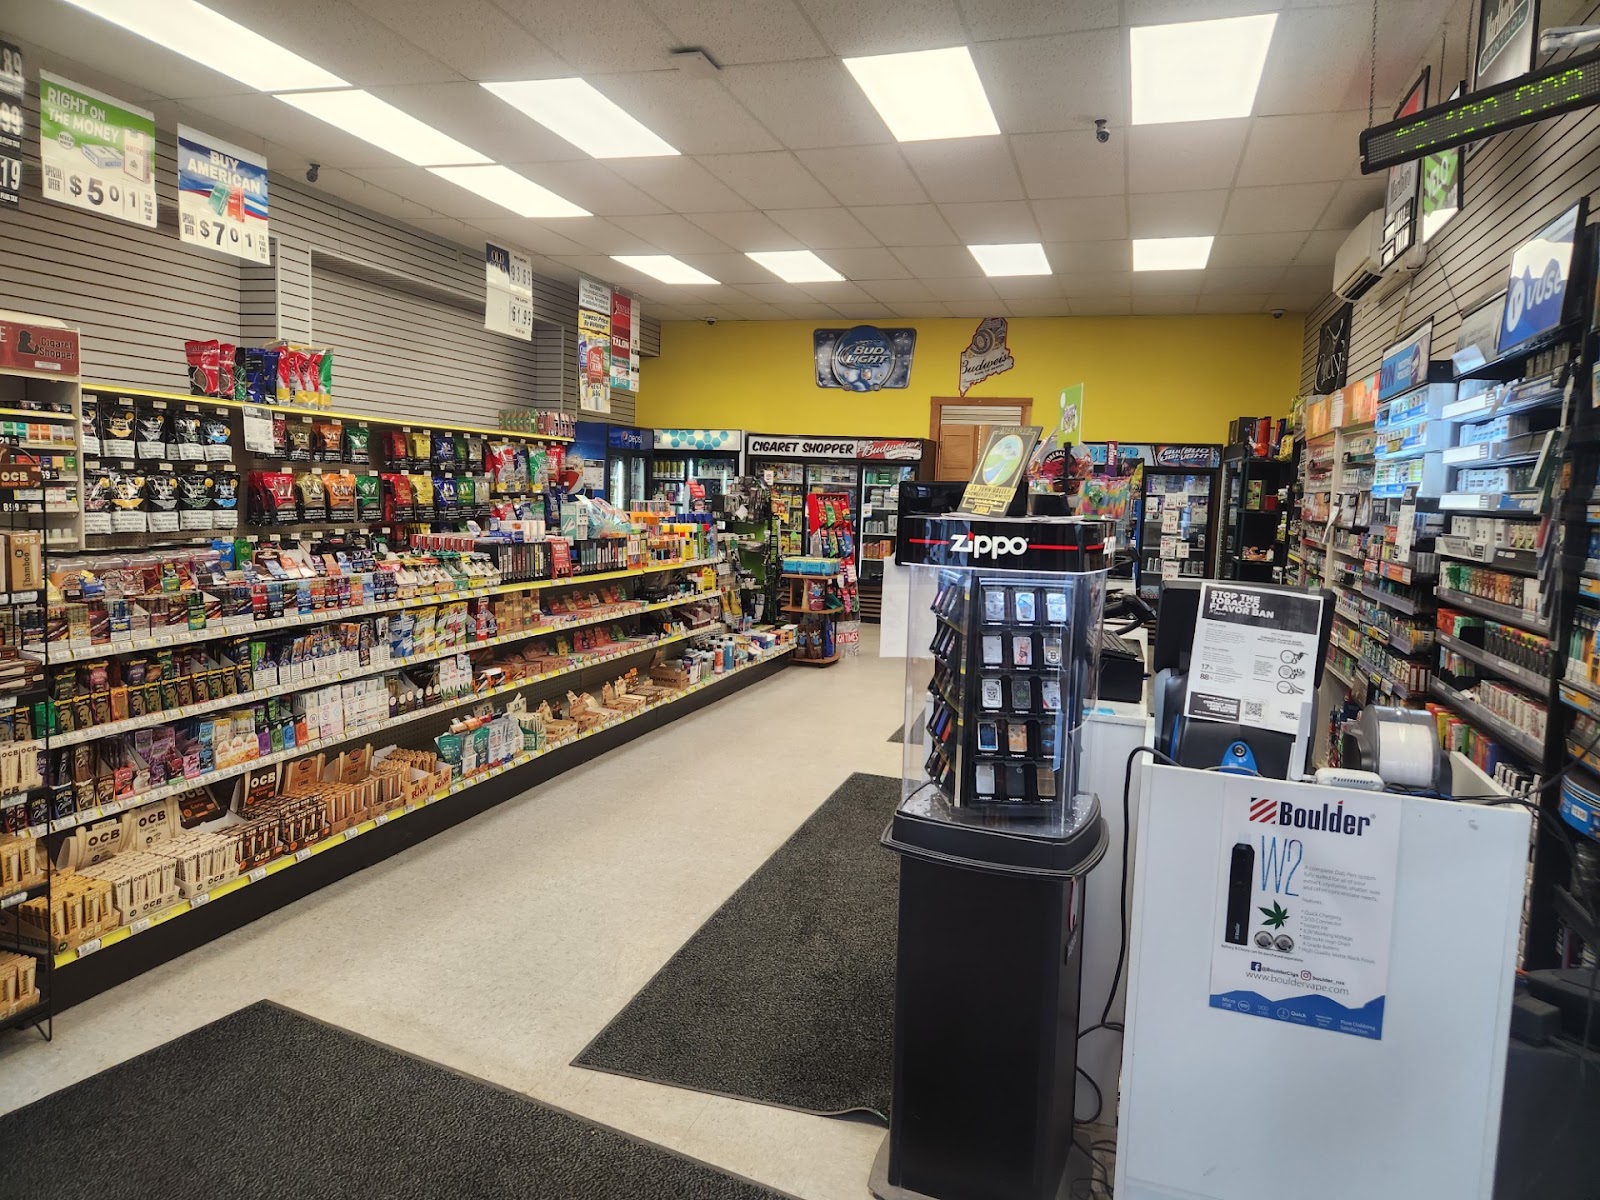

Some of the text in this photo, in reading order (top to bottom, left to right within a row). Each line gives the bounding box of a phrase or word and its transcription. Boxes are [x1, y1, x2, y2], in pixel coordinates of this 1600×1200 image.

[47, 87, 106, 121] RIGHT ON
[48, 108, 70, 126] THE
[72, 114, 120, 143] MONEY
[210, 150, 239, 172] BUY
[45, 164, 62, 180] SPECIAL
[187, 158, 260, 194] AMERICAN
[48, 178, 60, 191] OFFER
[491, 250, 504, 264] OLD
[41, 337, 73, 349] Cigaret
[39, 347, 75, 360] Shopper
[853, 345, 886, 355] BUD
[846, 353, 889, 364] LIGHT
[628, 434, 643, 444] pepsi
[752, 441, 854, 454] CIGARET SHOPPER
[863, 440, 921, 457] Budweiser
[1, 471, 28, 481] OCB
[1211, 590, 1261, 604] STOP THE
[1211, 596, 1260, 609] TOBACCO
[1209, 603, 1274, 619] FLAVOR BAN
[2, 749, 18, 758] OCB
[21, 745, 37, 753] OCB
[250, 772, 276, 788] OCB
[138, 810, 166, 827] OCB
[1279, 800, 1370, 836] Boulder
[88, 828, 120, 847] OCB
[304, 832, 319, 843] OCB
[214, 846, 226, 854] OCB
[255, 850, 270, 862] OCB
[185, 855, 197, 863] OCB
[1261, 834, 1303, 897] W2
[147, 867, 161, 876] OCB
[163, 863, 176, 871] OCB
[133, 873, 147, 882] OCB
[208, 873, 225, 885] OCB
[143, 898, 162, 911] OCB
[79, 925, 102, 939] OCB
[1245, 971, 1350, 996] www.bouldervape.com
[1291, 1010, 1307, 1019] Quick
